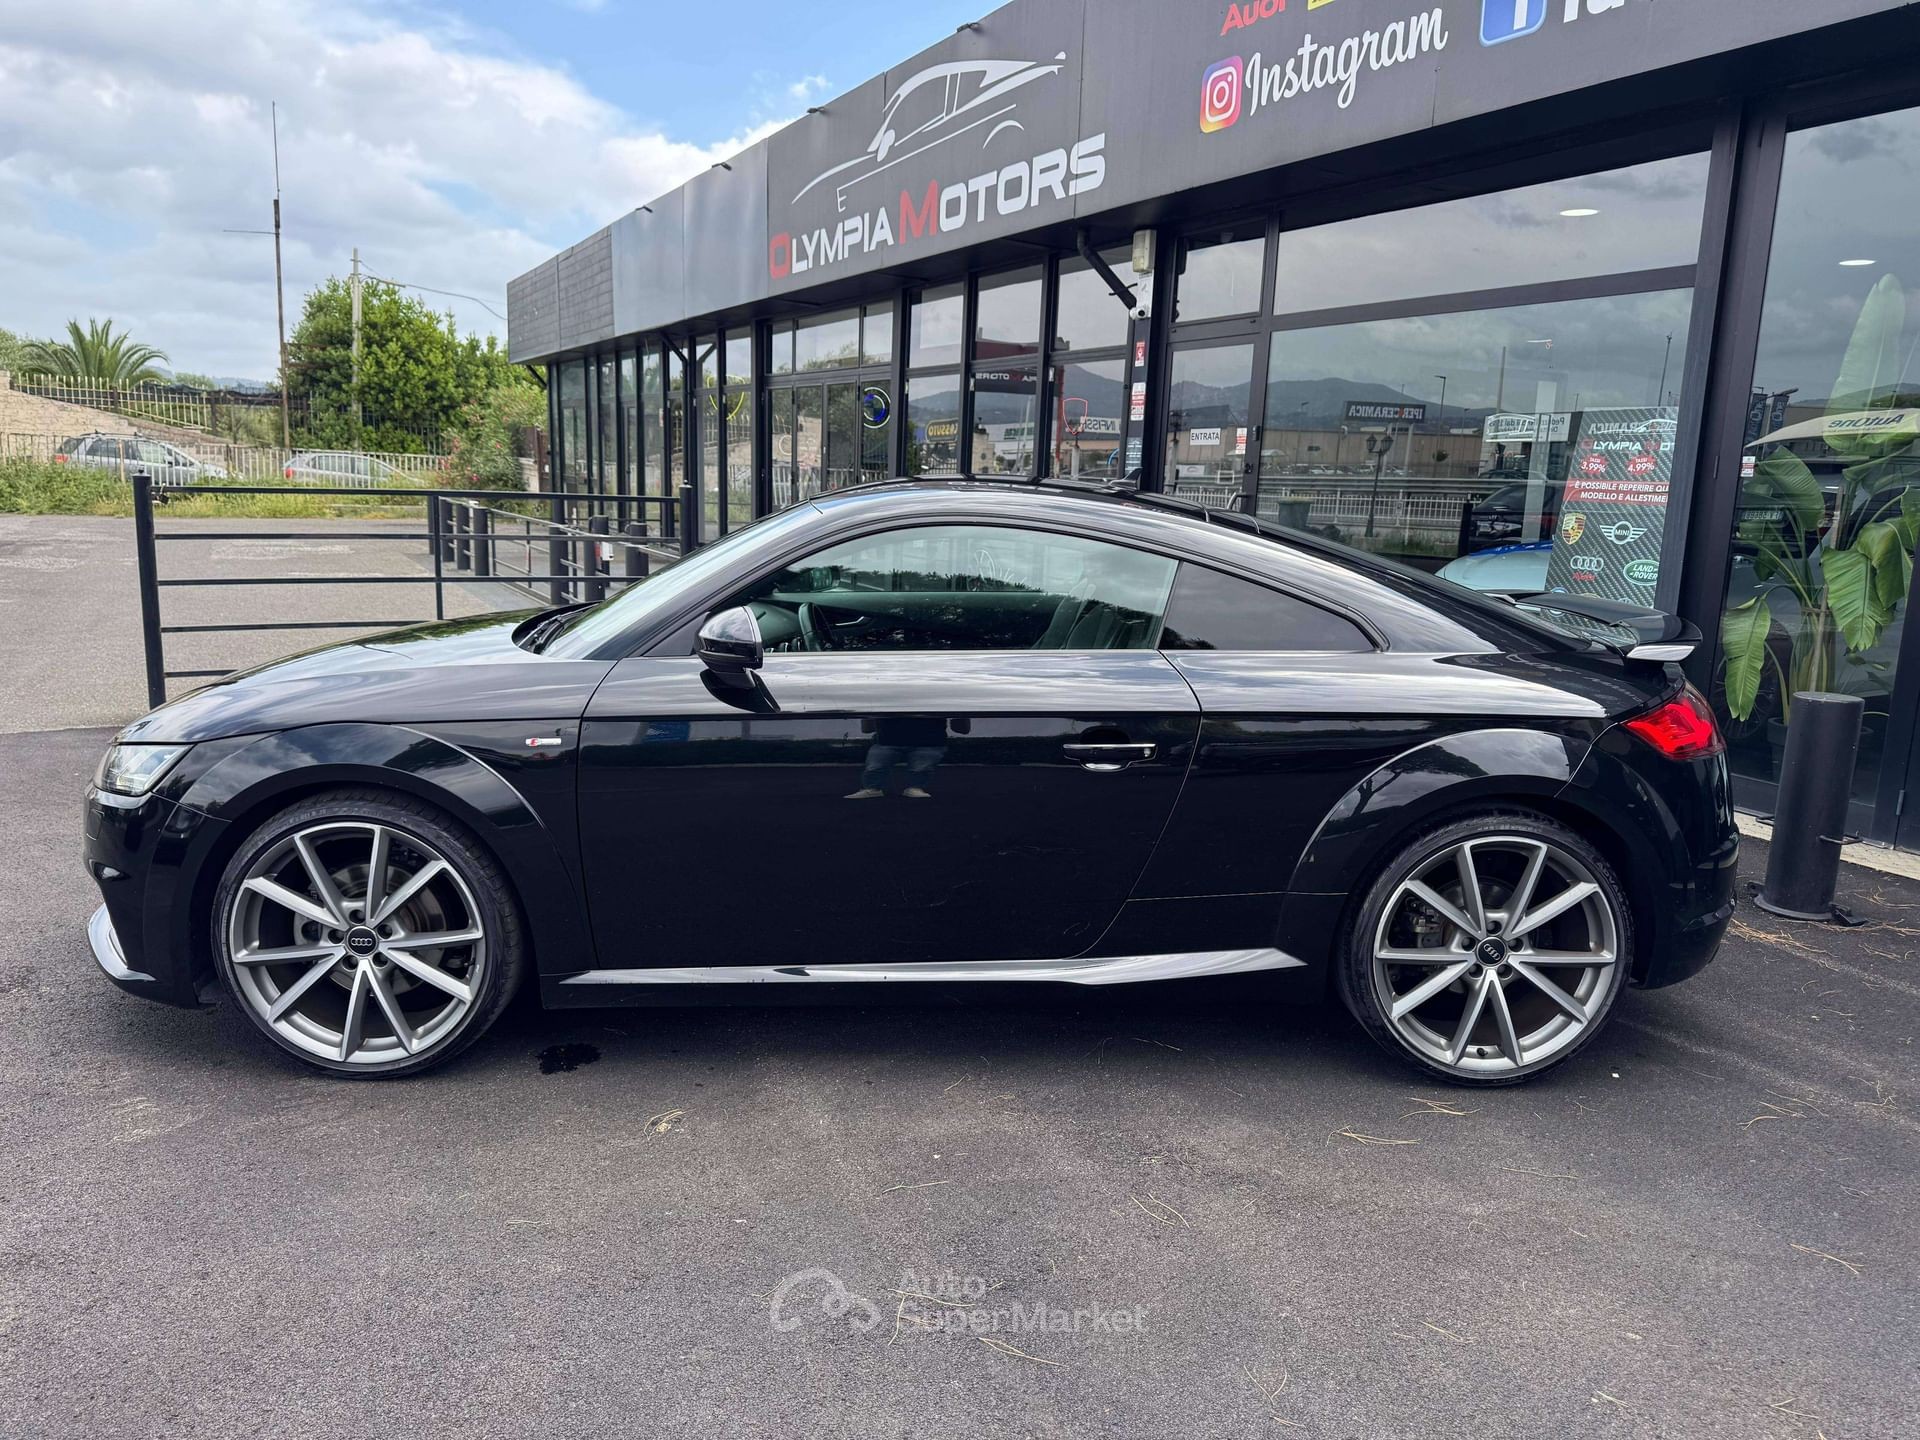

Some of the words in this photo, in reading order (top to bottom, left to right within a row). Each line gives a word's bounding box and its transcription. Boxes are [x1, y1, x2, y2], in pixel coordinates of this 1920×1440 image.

[1245, 8, 1449, 117] Instagram
[769, 206, 895, 280] OLYMPIA
[899, 132, 1106, 245] MOTORS
[1191, 432, 1220, 441] ENTRATA
[1581, 461, 1606, 473] 3.99%
[1627, 462, 1655, 473] 4.99%
[1581, 481, 1617, 491] POSSIBILE
[1618, 482, 1655, 492] REPERIRE
[1580, 491, 1617, 500] MODELLO
[1618, 493, 1624, 501] E
[1624, 493, 1668, 503] ALLESTIME
[1614, 528, 1630, 536] MINI
